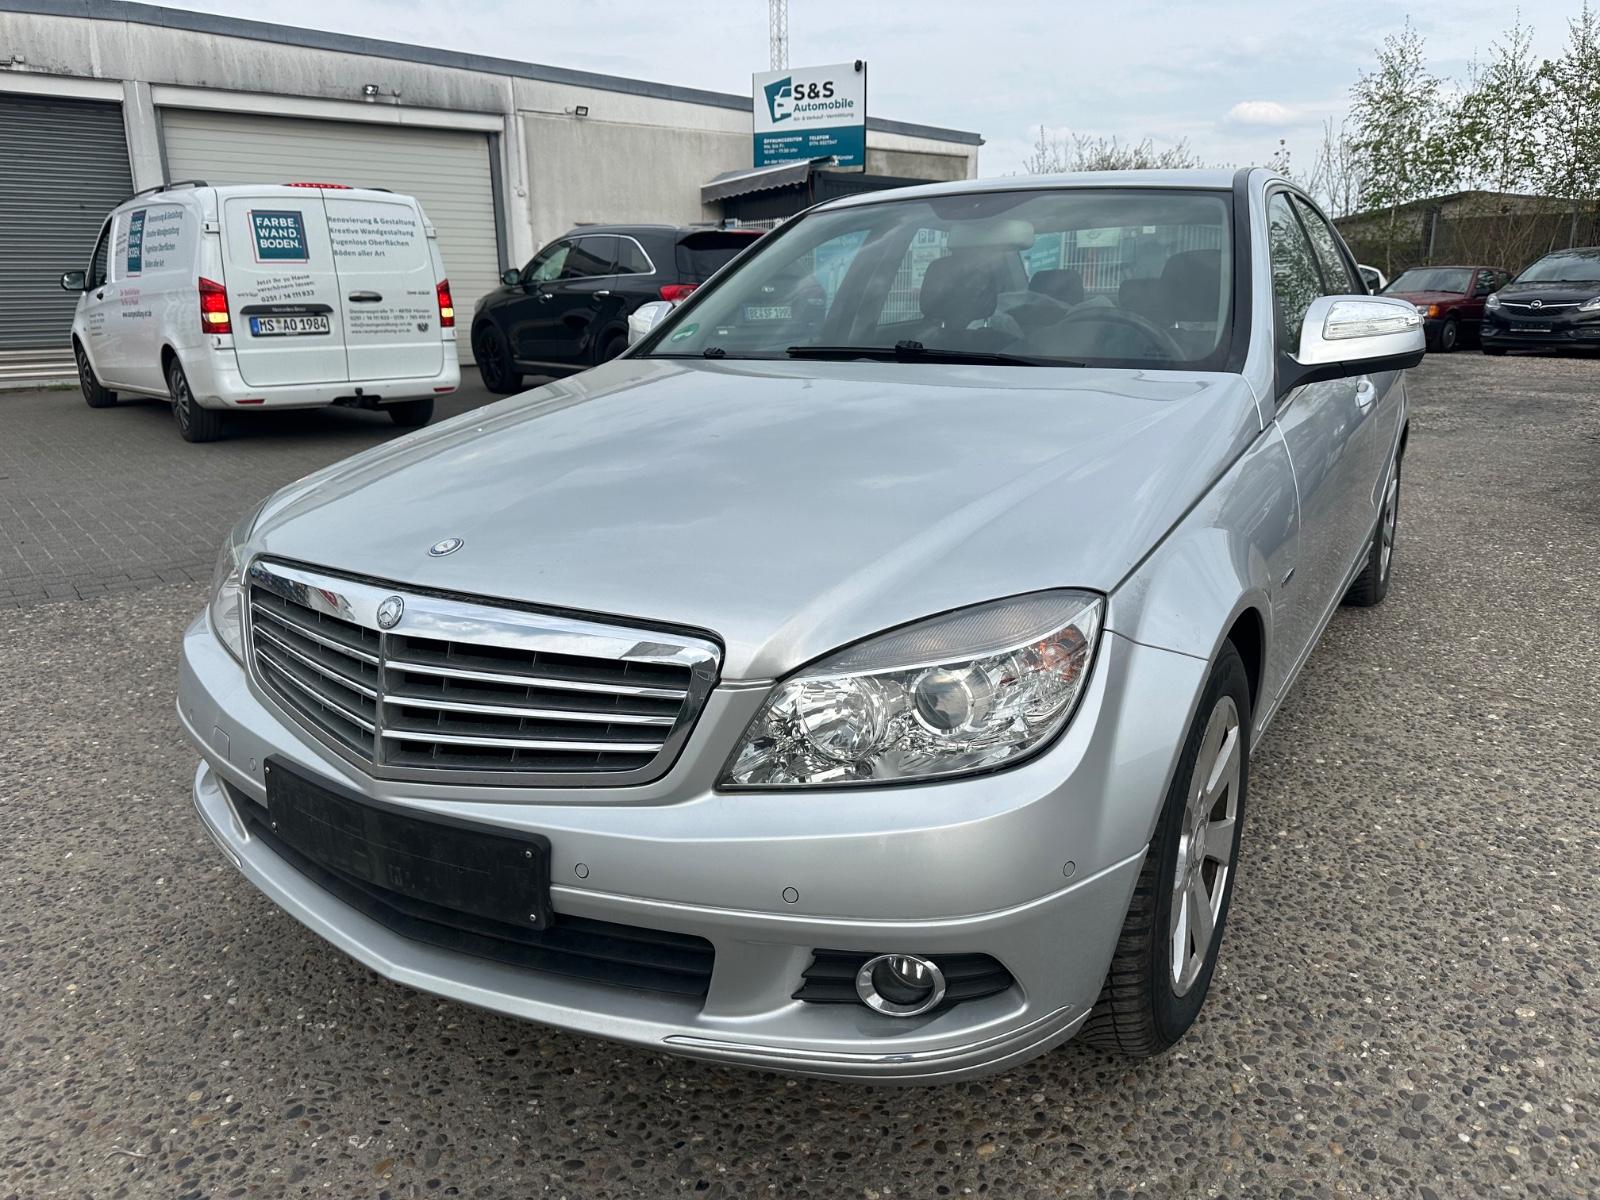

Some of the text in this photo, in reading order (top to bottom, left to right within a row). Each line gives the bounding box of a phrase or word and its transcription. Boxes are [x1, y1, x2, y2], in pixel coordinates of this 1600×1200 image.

[793, 81, 835, 101] S&S
[793, 98, 854, 113] Automobile
[256, 217, 298, 227] FARBE.
[327, 216, 416, 227] Renovierung & Gestaltung
[258, 228, 300, 238] WAND.
[360, 227, 414, 237] Wandgestaltung
[260, 238, 302, 249] BODEN.
[331, 238, 410, 247] Fugenlose Oberflächen
[333, 249, 386, 257] Böden aller Art
[261, 295, 277, 303] 0251
[259, 319, 275, 332] MS
[299, 318, 327, 331] 1984
